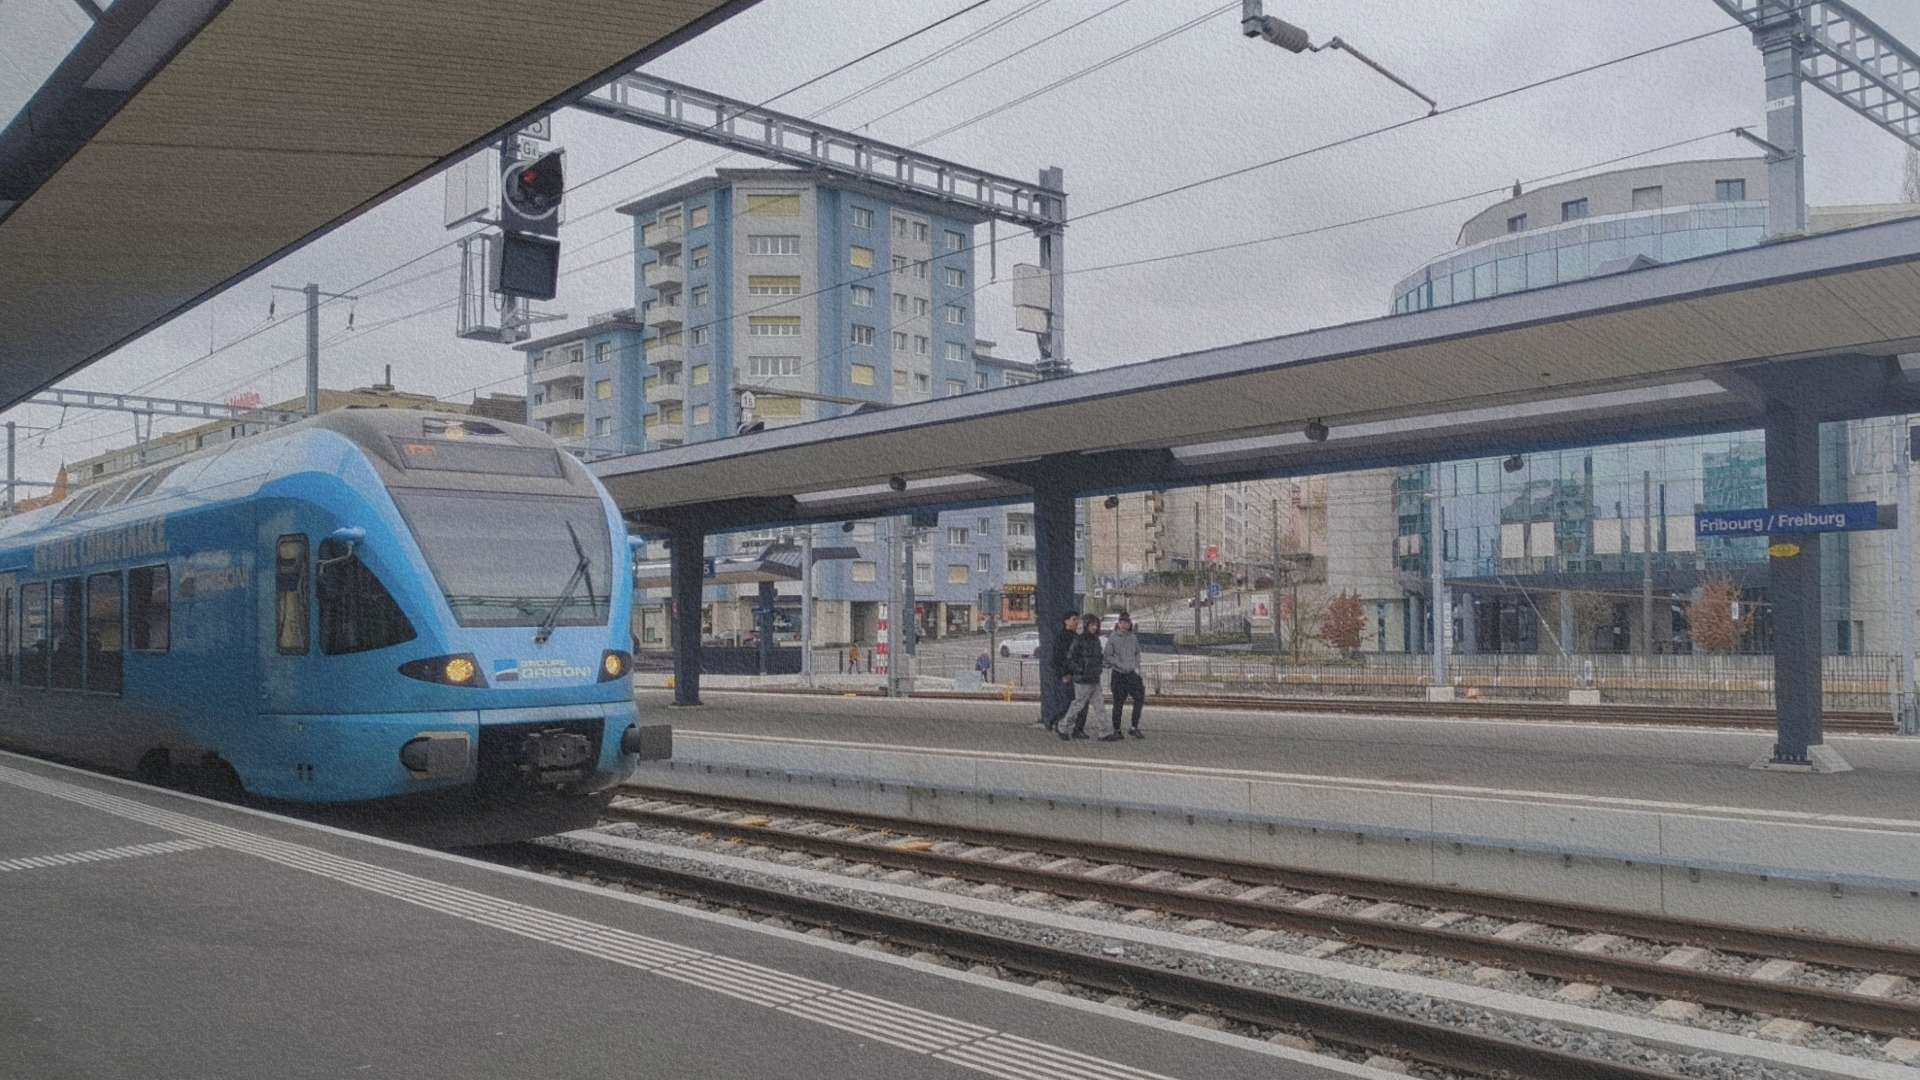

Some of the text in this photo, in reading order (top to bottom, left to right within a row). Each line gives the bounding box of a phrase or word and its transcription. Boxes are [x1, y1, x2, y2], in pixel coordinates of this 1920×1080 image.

[1700, 517, 1763, 532] Fribourg
[1778, 512, 1846, 528] Freiburg
[520, 666, 593, 679] GRISONI
